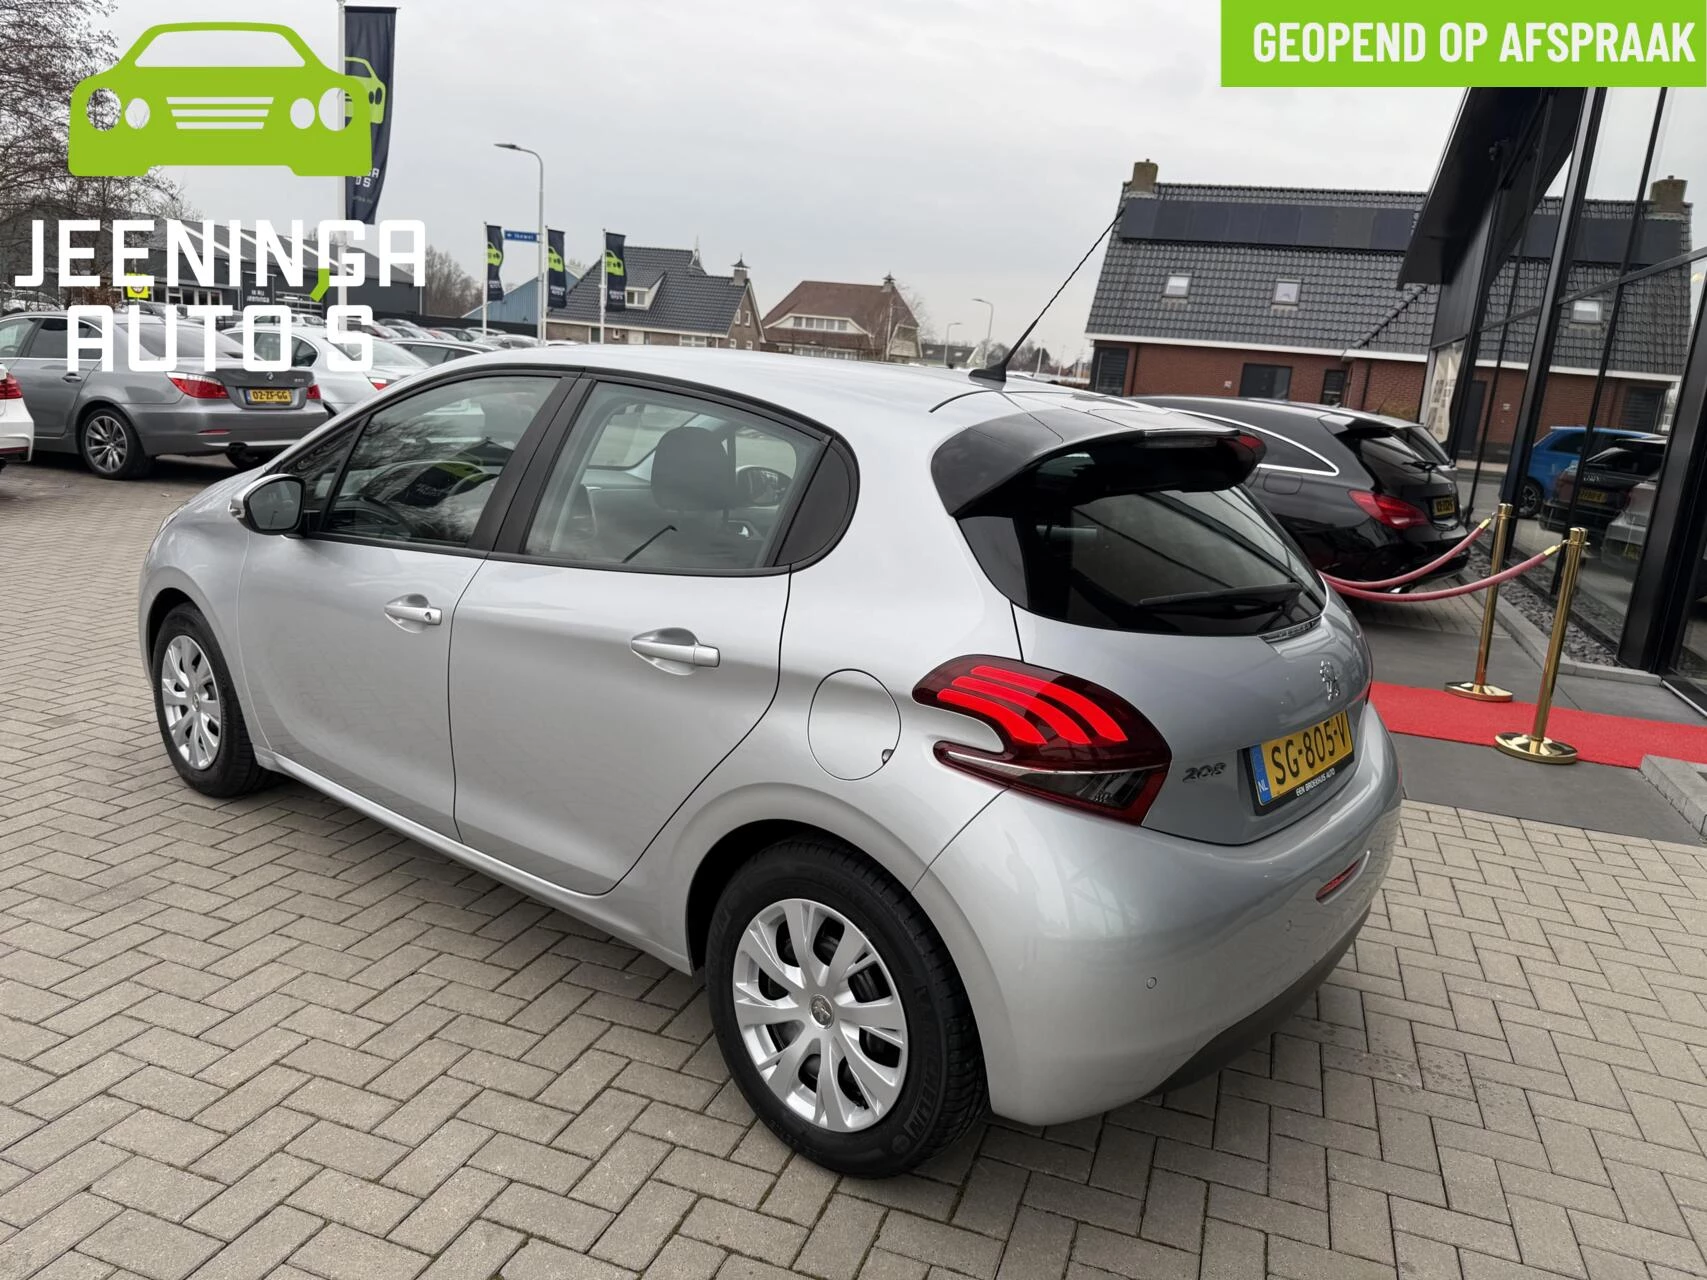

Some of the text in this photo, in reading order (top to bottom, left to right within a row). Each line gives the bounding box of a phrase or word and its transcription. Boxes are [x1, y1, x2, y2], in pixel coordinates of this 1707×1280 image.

[252, 390, 288, 400] 02-ZF-GG
[1271, 712, 1348, 786] SG-805-V
[1182, 761, 1226, 782] 208
[1257, 779, 1269, 793] NL
